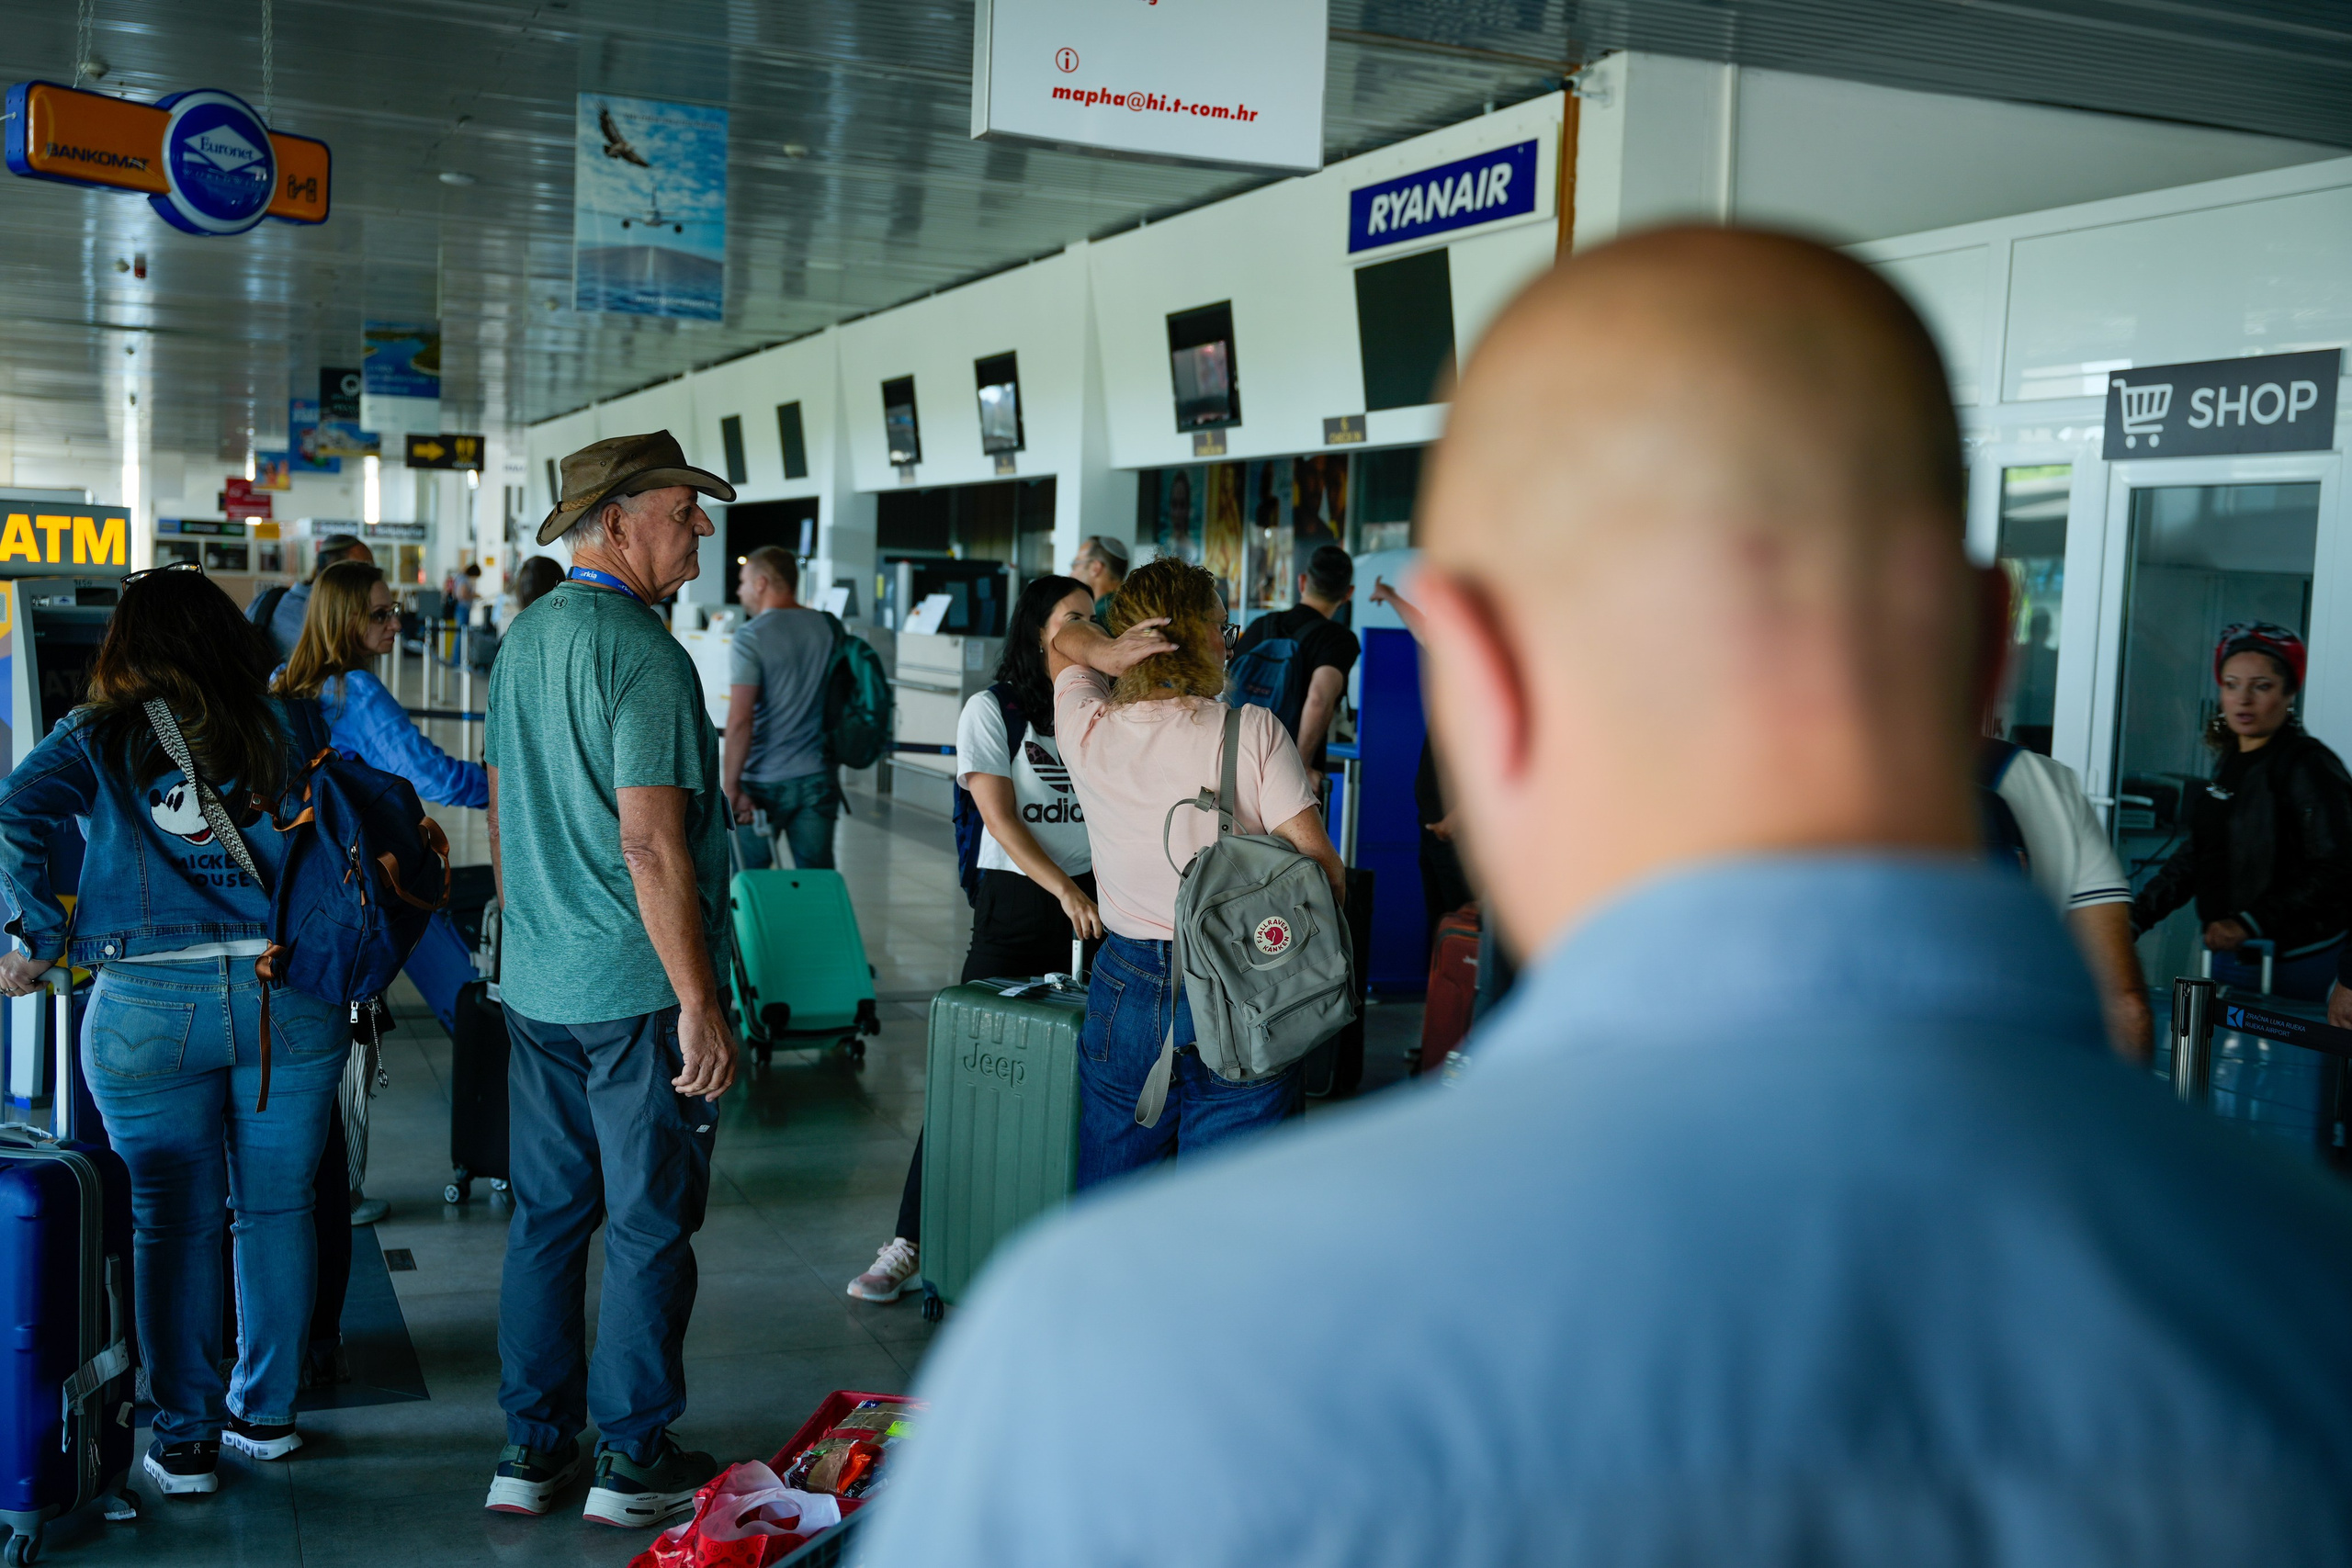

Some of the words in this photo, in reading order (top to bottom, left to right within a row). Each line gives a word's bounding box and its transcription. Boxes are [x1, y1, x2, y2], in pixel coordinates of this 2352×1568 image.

[1052, 85, 1259, 122] mapha@hi.t-com.hr
[46, 142, 150, 172] BANKOMAT
[199, 136, 254, 161] Euronet
[1367, 163, 1513, 236] RYANAIR
[2188, 379, 2318, 429] SHOP
[0, 513, 127, 566] ATM
[170, 853, 241, 870] MICKE
[186, 872, 252, 888] OUSE
[2245, 1021, 2264, 1031] RIJEKA
[2266, 1027, 2290, 1037] AIRPORT
[2269, 1018, 2285, 1028] LUKA
[2286, 1021, 2306, 1032] RIJEKA
[963, 1043, 1025, 1089] Jeep
